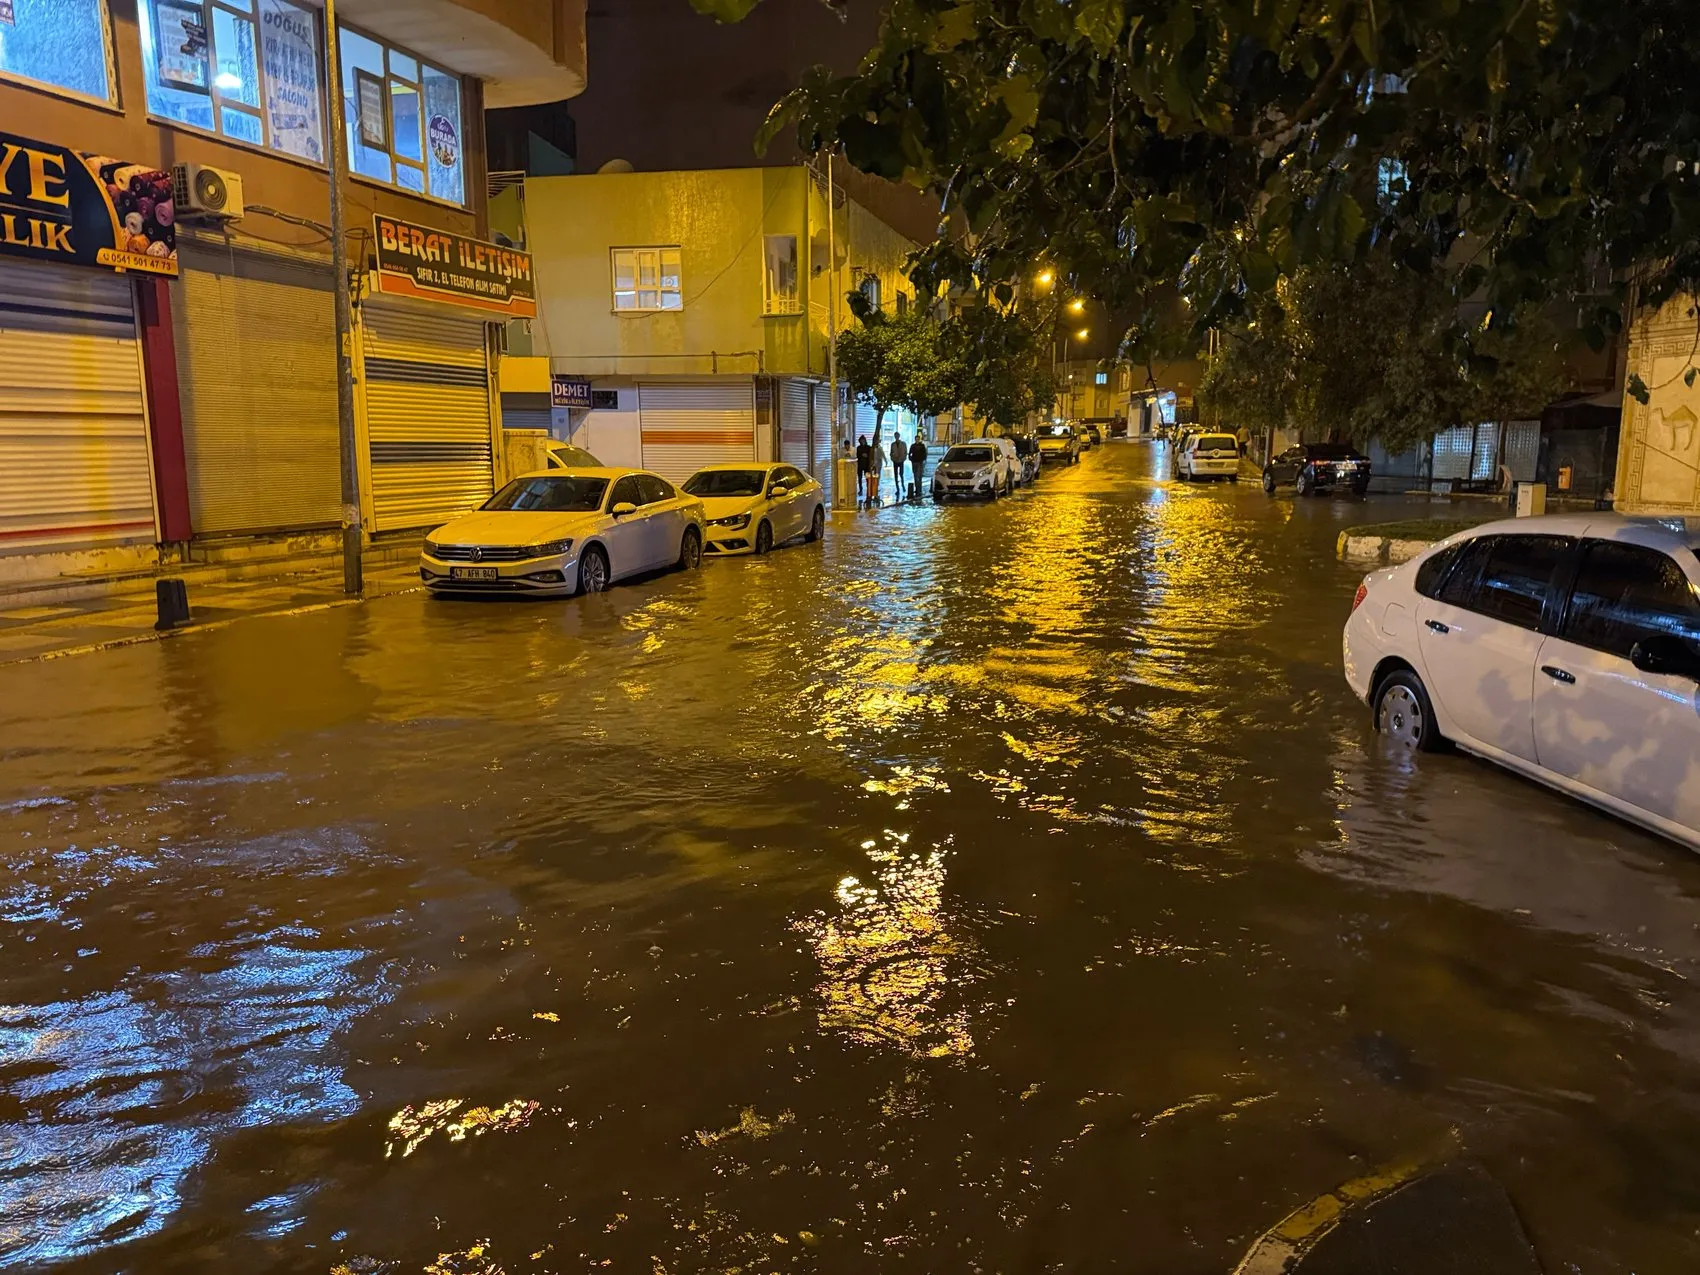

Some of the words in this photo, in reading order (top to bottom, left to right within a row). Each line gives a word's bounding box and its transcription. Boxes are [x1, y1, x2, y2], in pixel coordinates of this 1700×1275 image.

[430, 128, 456, 145] BURADA
[380, 219, 452, 264] BERAT
[458, 240, 531, 284] İLETİŞİM
[111, 254, 131, 265] 0541
[133, 257, 147, 266] 501
[150, 259, 160, 269] 47
[161, 261, 171, 271] 73
[416, 266, 434, 283] SIFIR
[442, 273, 449, 286] EL
[449, 273, 475, 290] TELEFON
[475, 279, 488, 293] ALIM
[489, 282, 507, 297] SATIMI
[554, 383, 588, 397] DEMET
